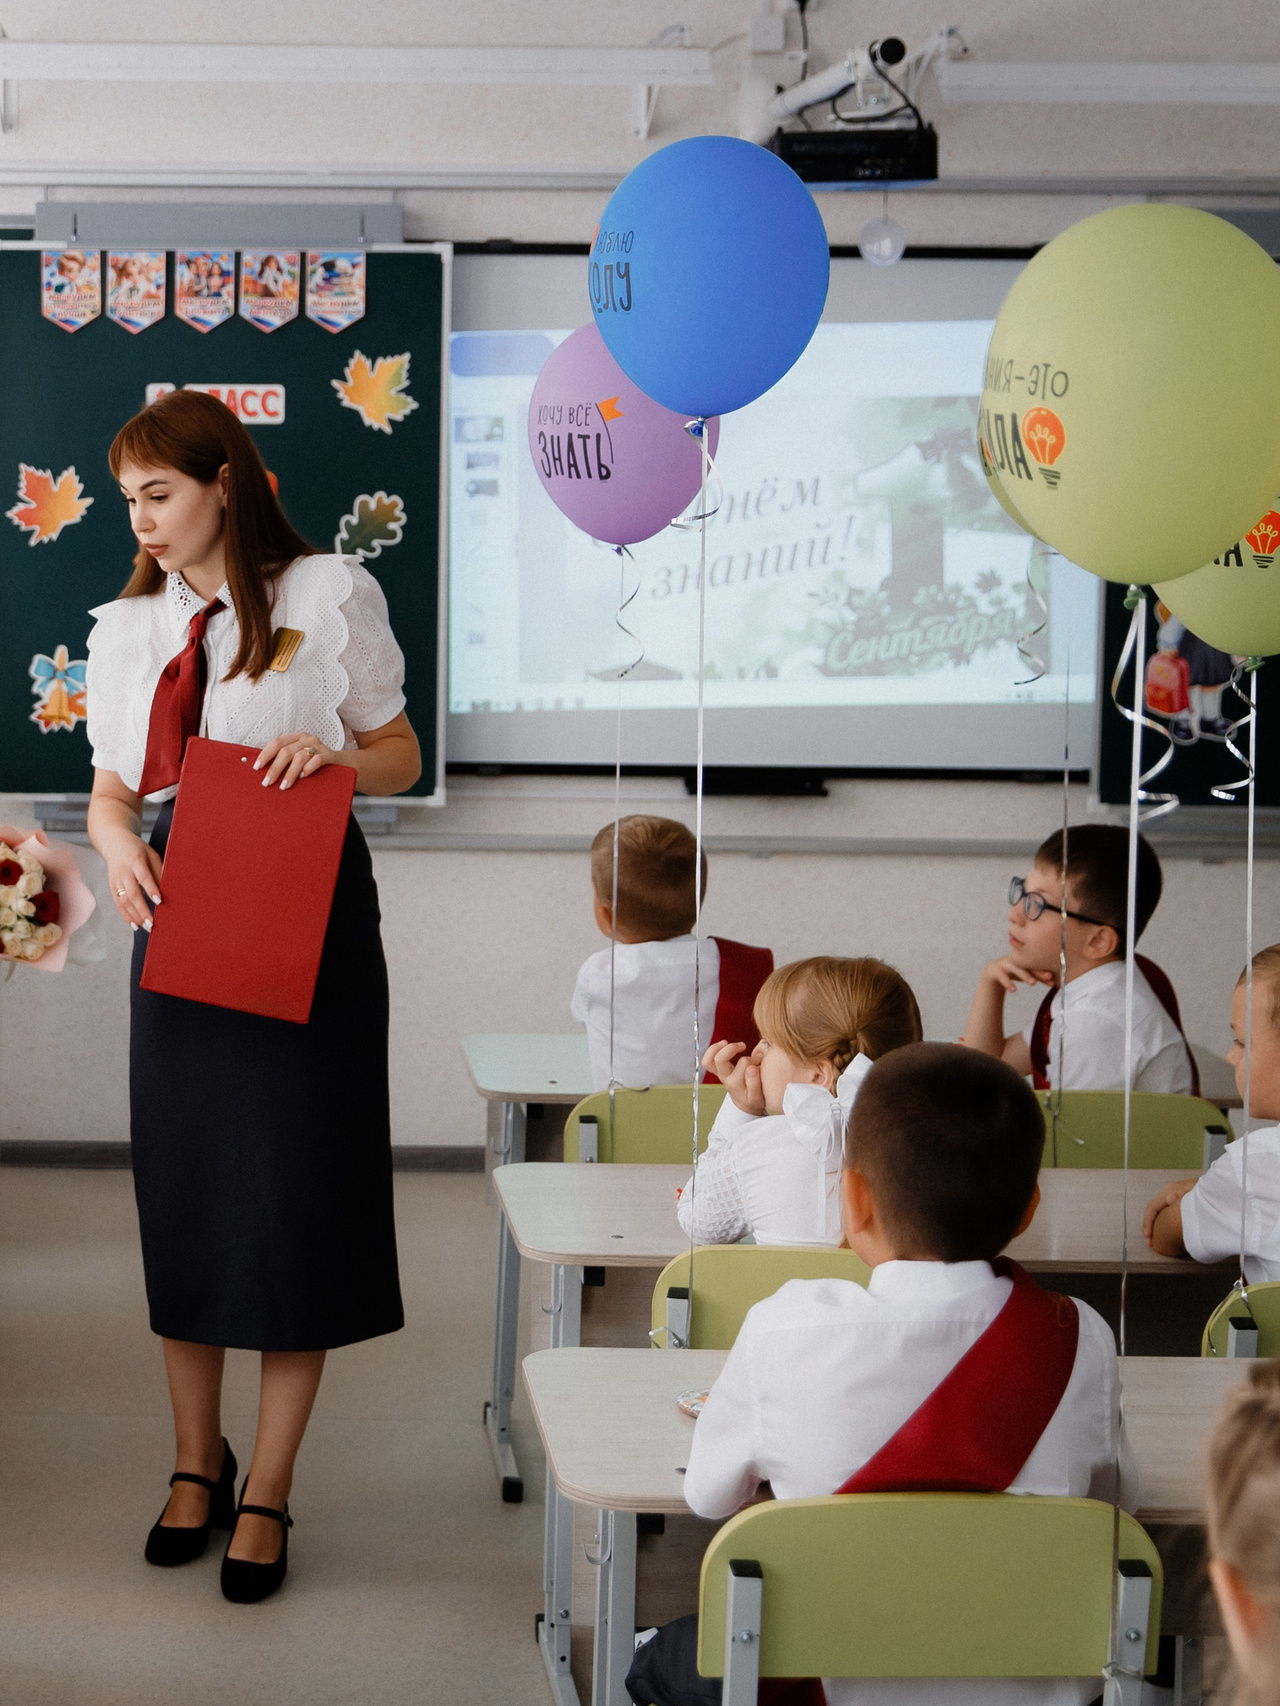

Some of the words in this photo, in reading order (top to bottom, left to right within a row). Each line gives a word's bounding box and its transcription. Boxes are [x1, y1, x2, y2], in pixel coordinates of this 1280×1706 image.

[589, 261, 632, 313] ОЛУ
[568, 402, 592, 427] ВСЁ
[538, 430, 612, 481] ЗНАТЬ
